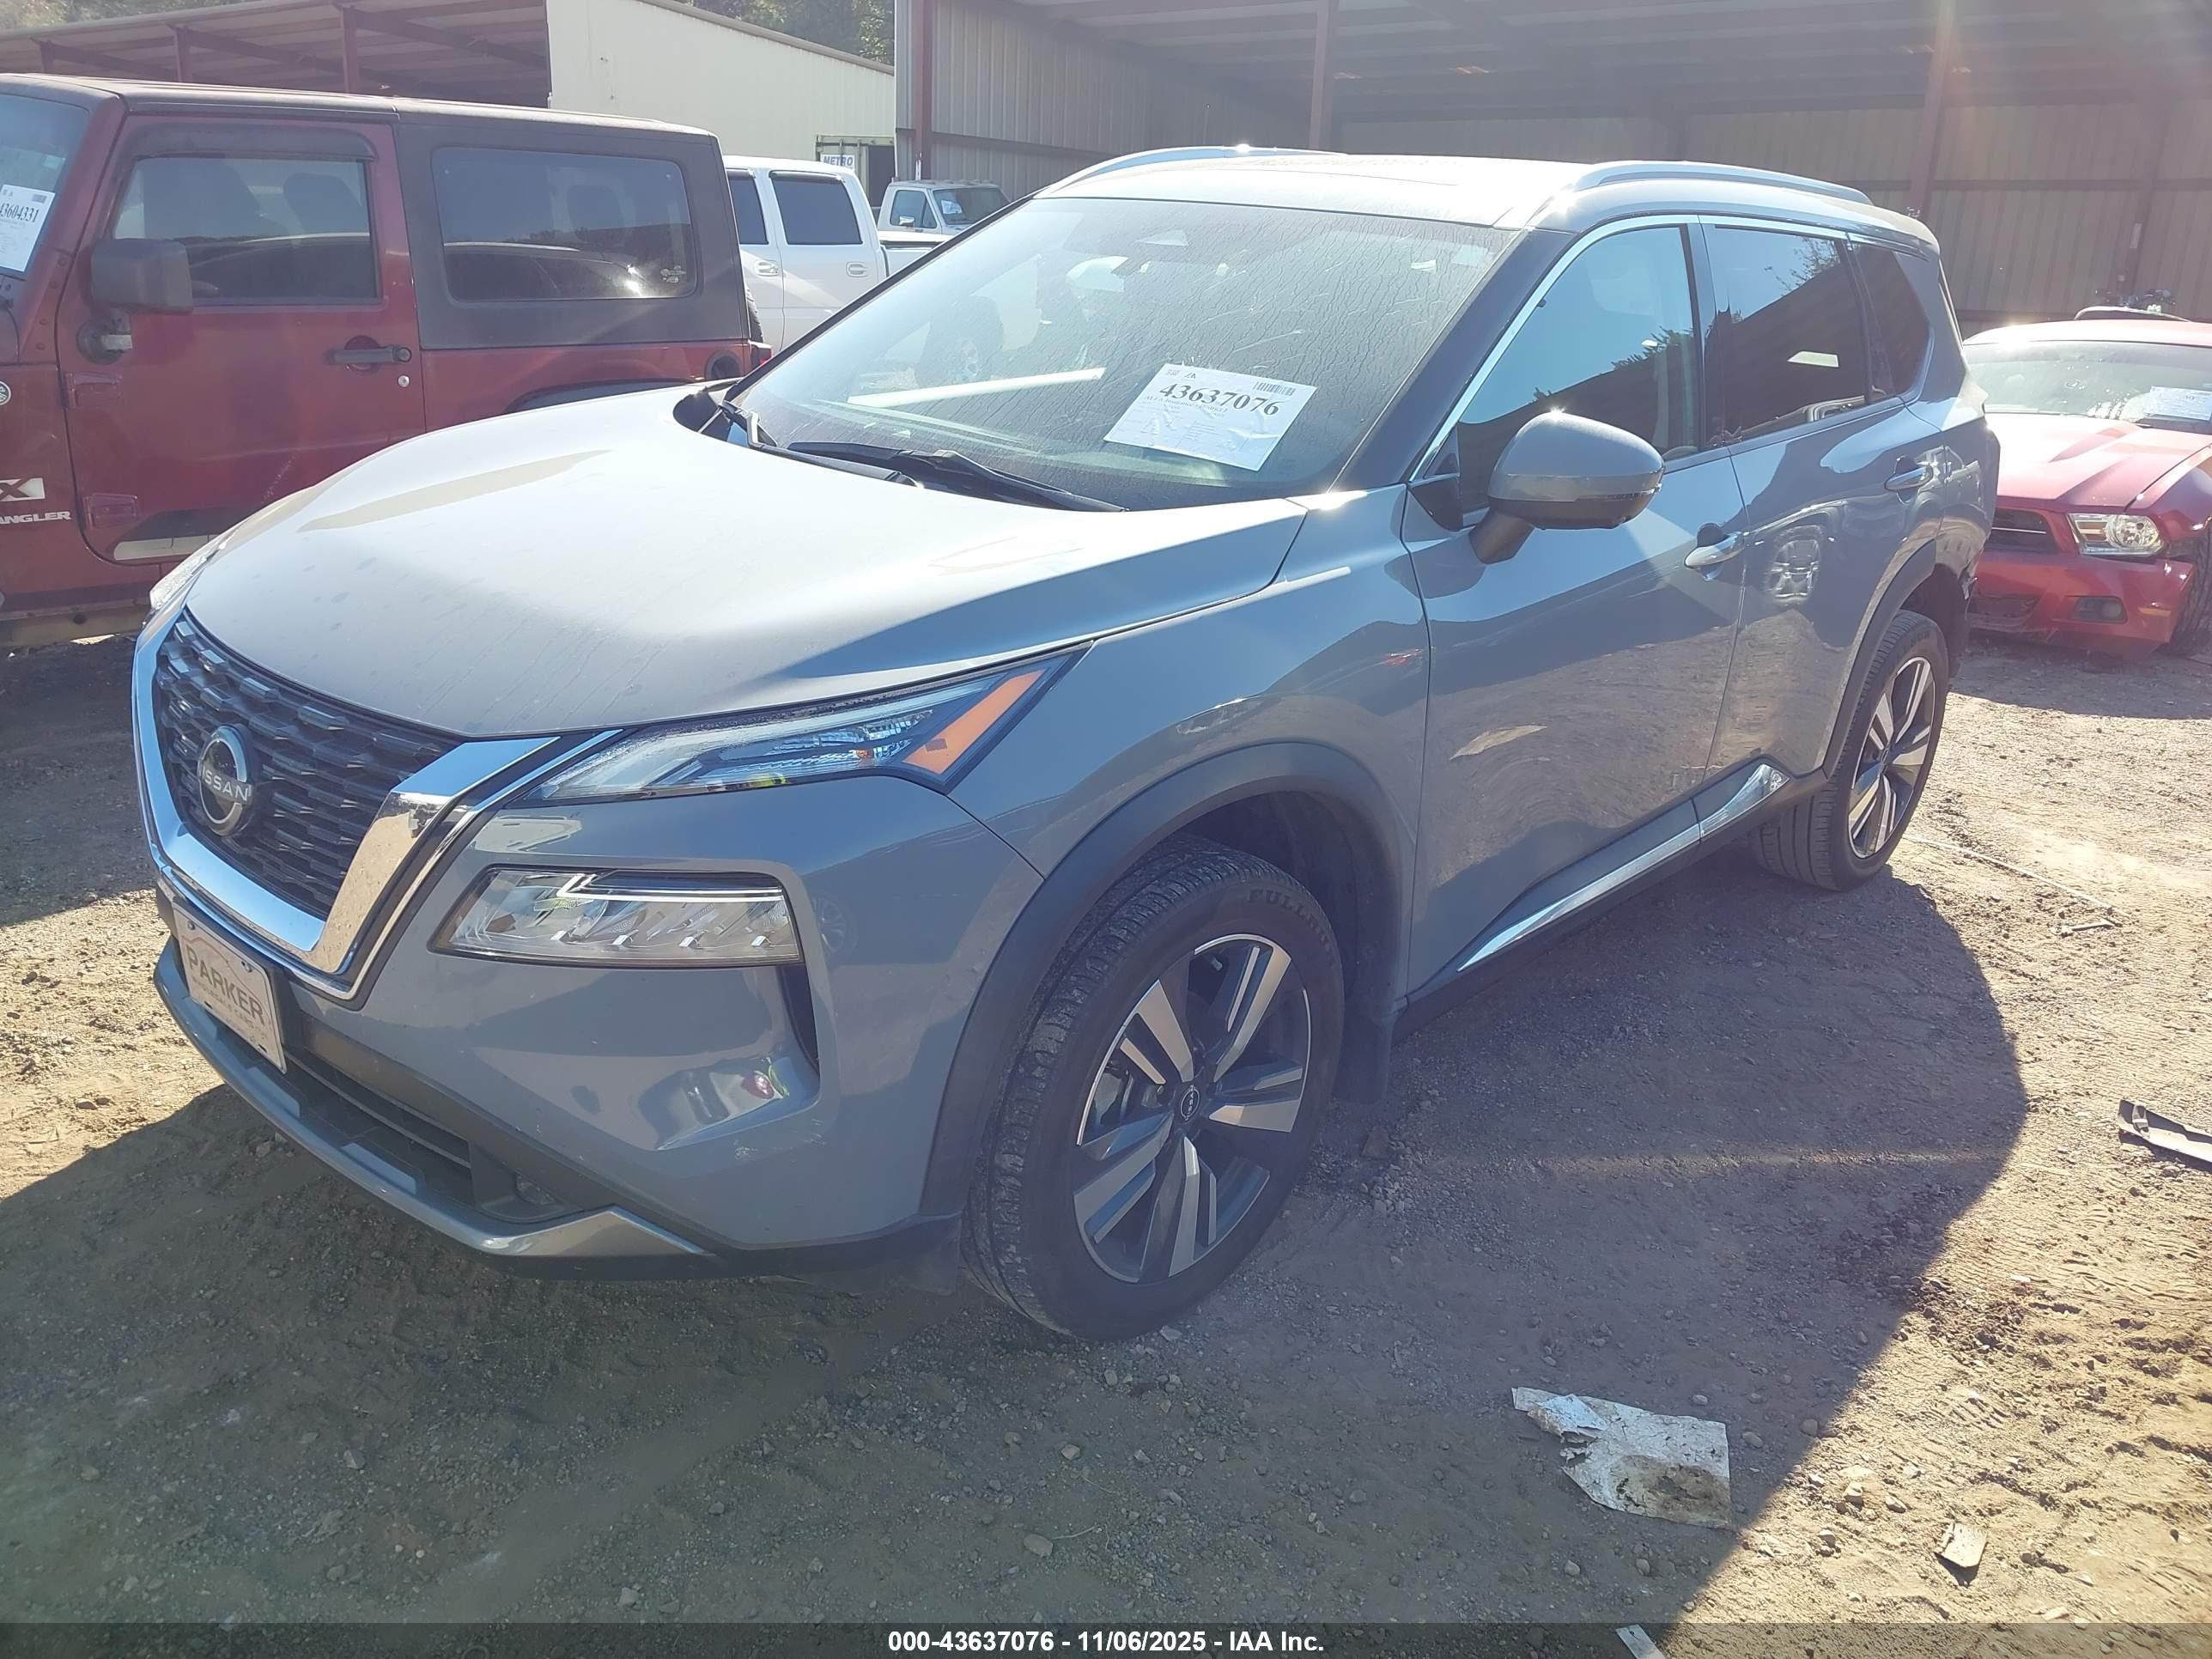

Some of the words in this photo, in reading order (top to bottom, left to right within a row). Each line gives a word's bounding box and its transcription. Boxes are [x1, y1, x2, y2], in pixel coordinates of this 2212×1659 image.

[823, 155, 854, 167] METRO
[1159, 383, 1285, 416] 43637076
[185, 944, 265, 1025] PARKER
